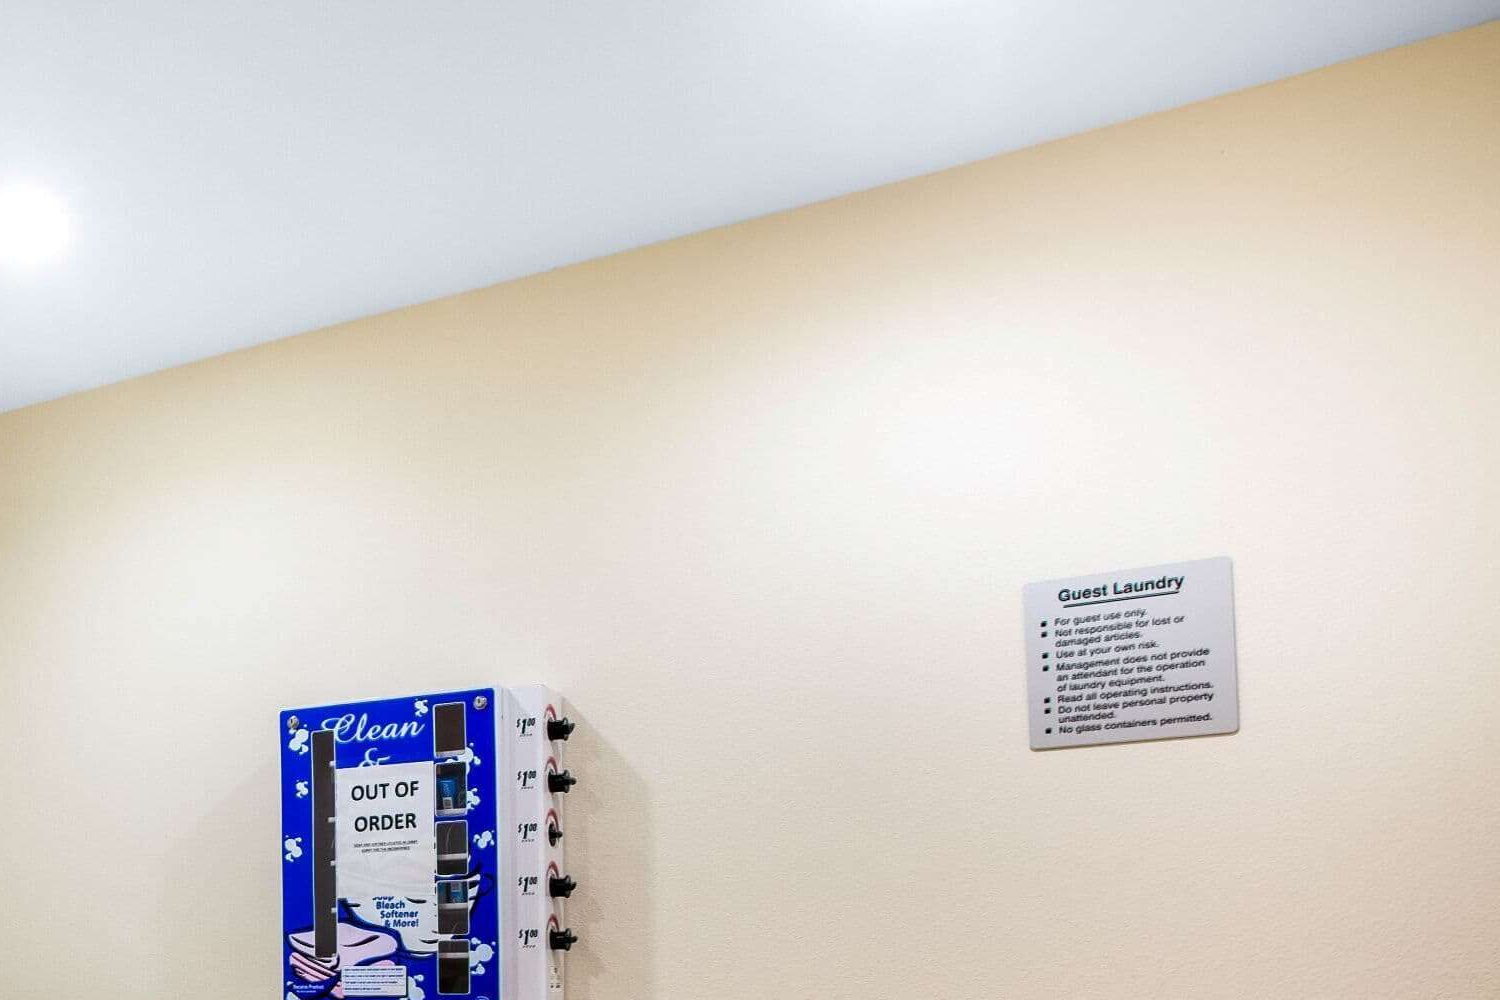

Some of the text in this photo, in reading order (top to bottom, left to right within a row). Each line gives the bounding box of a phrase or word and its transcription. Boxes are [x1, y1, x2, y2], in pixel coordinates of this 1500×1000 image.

[1058, 575, 1184, 602] Guest Laundry
[1054, 617, 1071, 626] For
[1073, 613, 1101, 626] guest
[1103, 611, 1121, 621] use
[1054, 615, 1185, 637] Not responsible for lost or
[1055, 636, 1101, 647] damaged
[1056, 650, 1074, 658] Use
[1090, 646, 1112, 657] your
[1114, 643, 1135, 652] own
[1138, 640, 1159, 649] risk.
[1056, 647, 1210, 671] Management does not provide
[1072, 669, 1118, 679] attendant
[1136, 664, 1153, 673] the
[1156, 660, 1205, 672] operation
[1057, 675, 1164, 692] of laundry equipment.
[1058, 682, 1213, 703] Read all operating instructions.
[1058, 693, 1213, 714] Do not leave personal property
[1059, 711, 1116, 723] unattended.
[1059, 713, 1212, 734] No glass containers permitted.
[321, 712, 425, 743] Clean
[351, 780, 419, 801] OUT OF
[354, 812, 417, 832] ORDER
[376, 900, 405, 910] Bleach
[380, 910, 419, 919] Softener
[392, 918, 419, 928] More!
